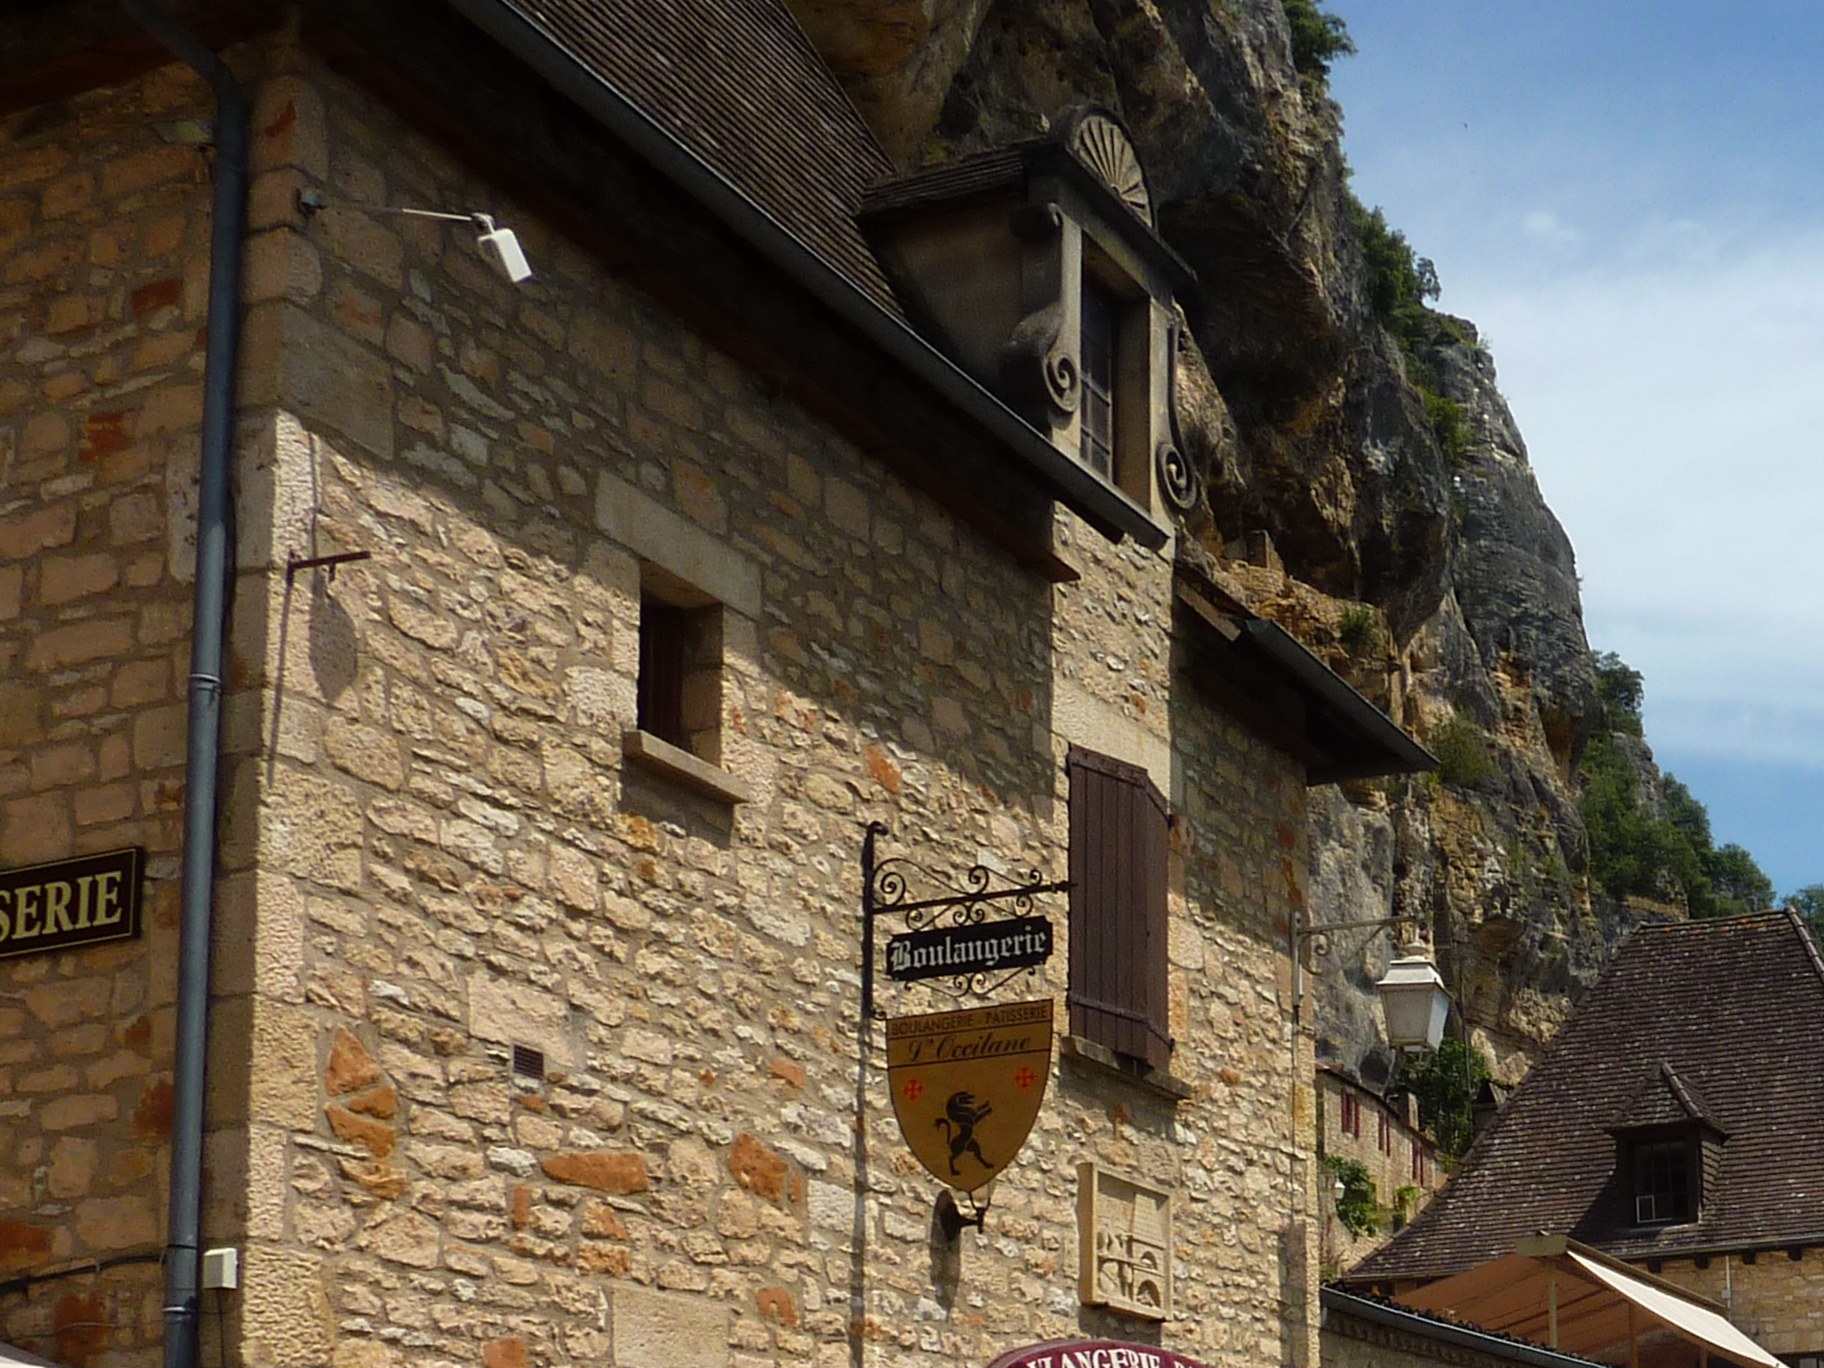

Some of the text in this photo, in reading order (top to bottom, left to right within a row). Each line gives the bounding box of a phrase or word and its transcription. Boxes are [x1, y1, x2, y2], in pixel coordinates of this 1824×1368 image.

[890, 925, 1047, 971] Boulangerie
[892, 1005, 1048, 1036] BOULANGERIE PATISSERIE
